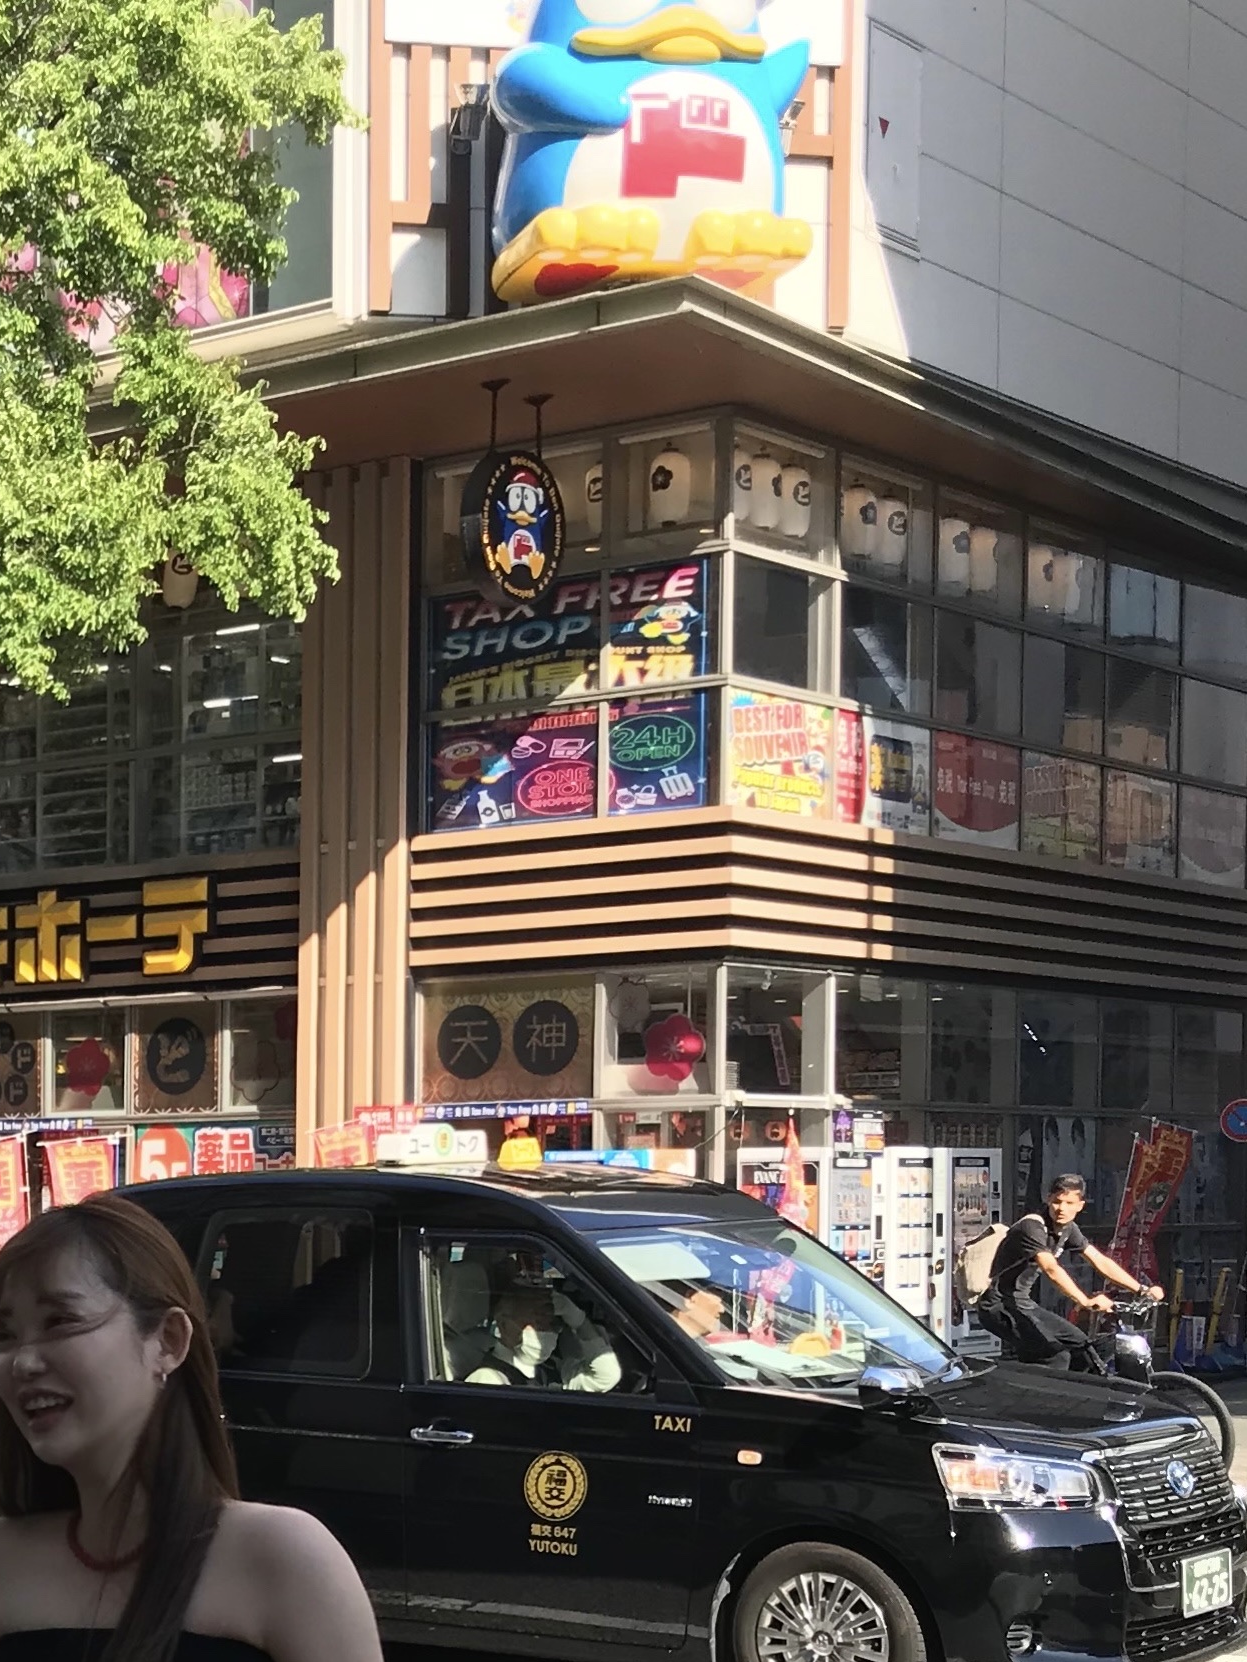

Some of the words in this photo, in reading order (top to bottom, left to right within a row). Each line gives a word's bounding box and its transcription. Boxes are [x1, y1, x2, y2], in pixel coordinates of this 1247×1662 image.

[445, 601, 534, 630] TAX
[554, 567, 699, 614] FREE
[442, 615, 592, 660] SHOP
[733, 706, 771, 734] BEST
[774, 703, 803, 730] FOR
[613, 725, 688, 750] 24H
[616, 746, 681, 763] OPEN
[534, 767, 590, 784] ONE
[528, 780, 596, 797] STOP
[448, 1015, 568, 1066] 天神
[654, 1415, 692, 1433] TAXI
[528, 1539, 578, 1556] YUTOKU
